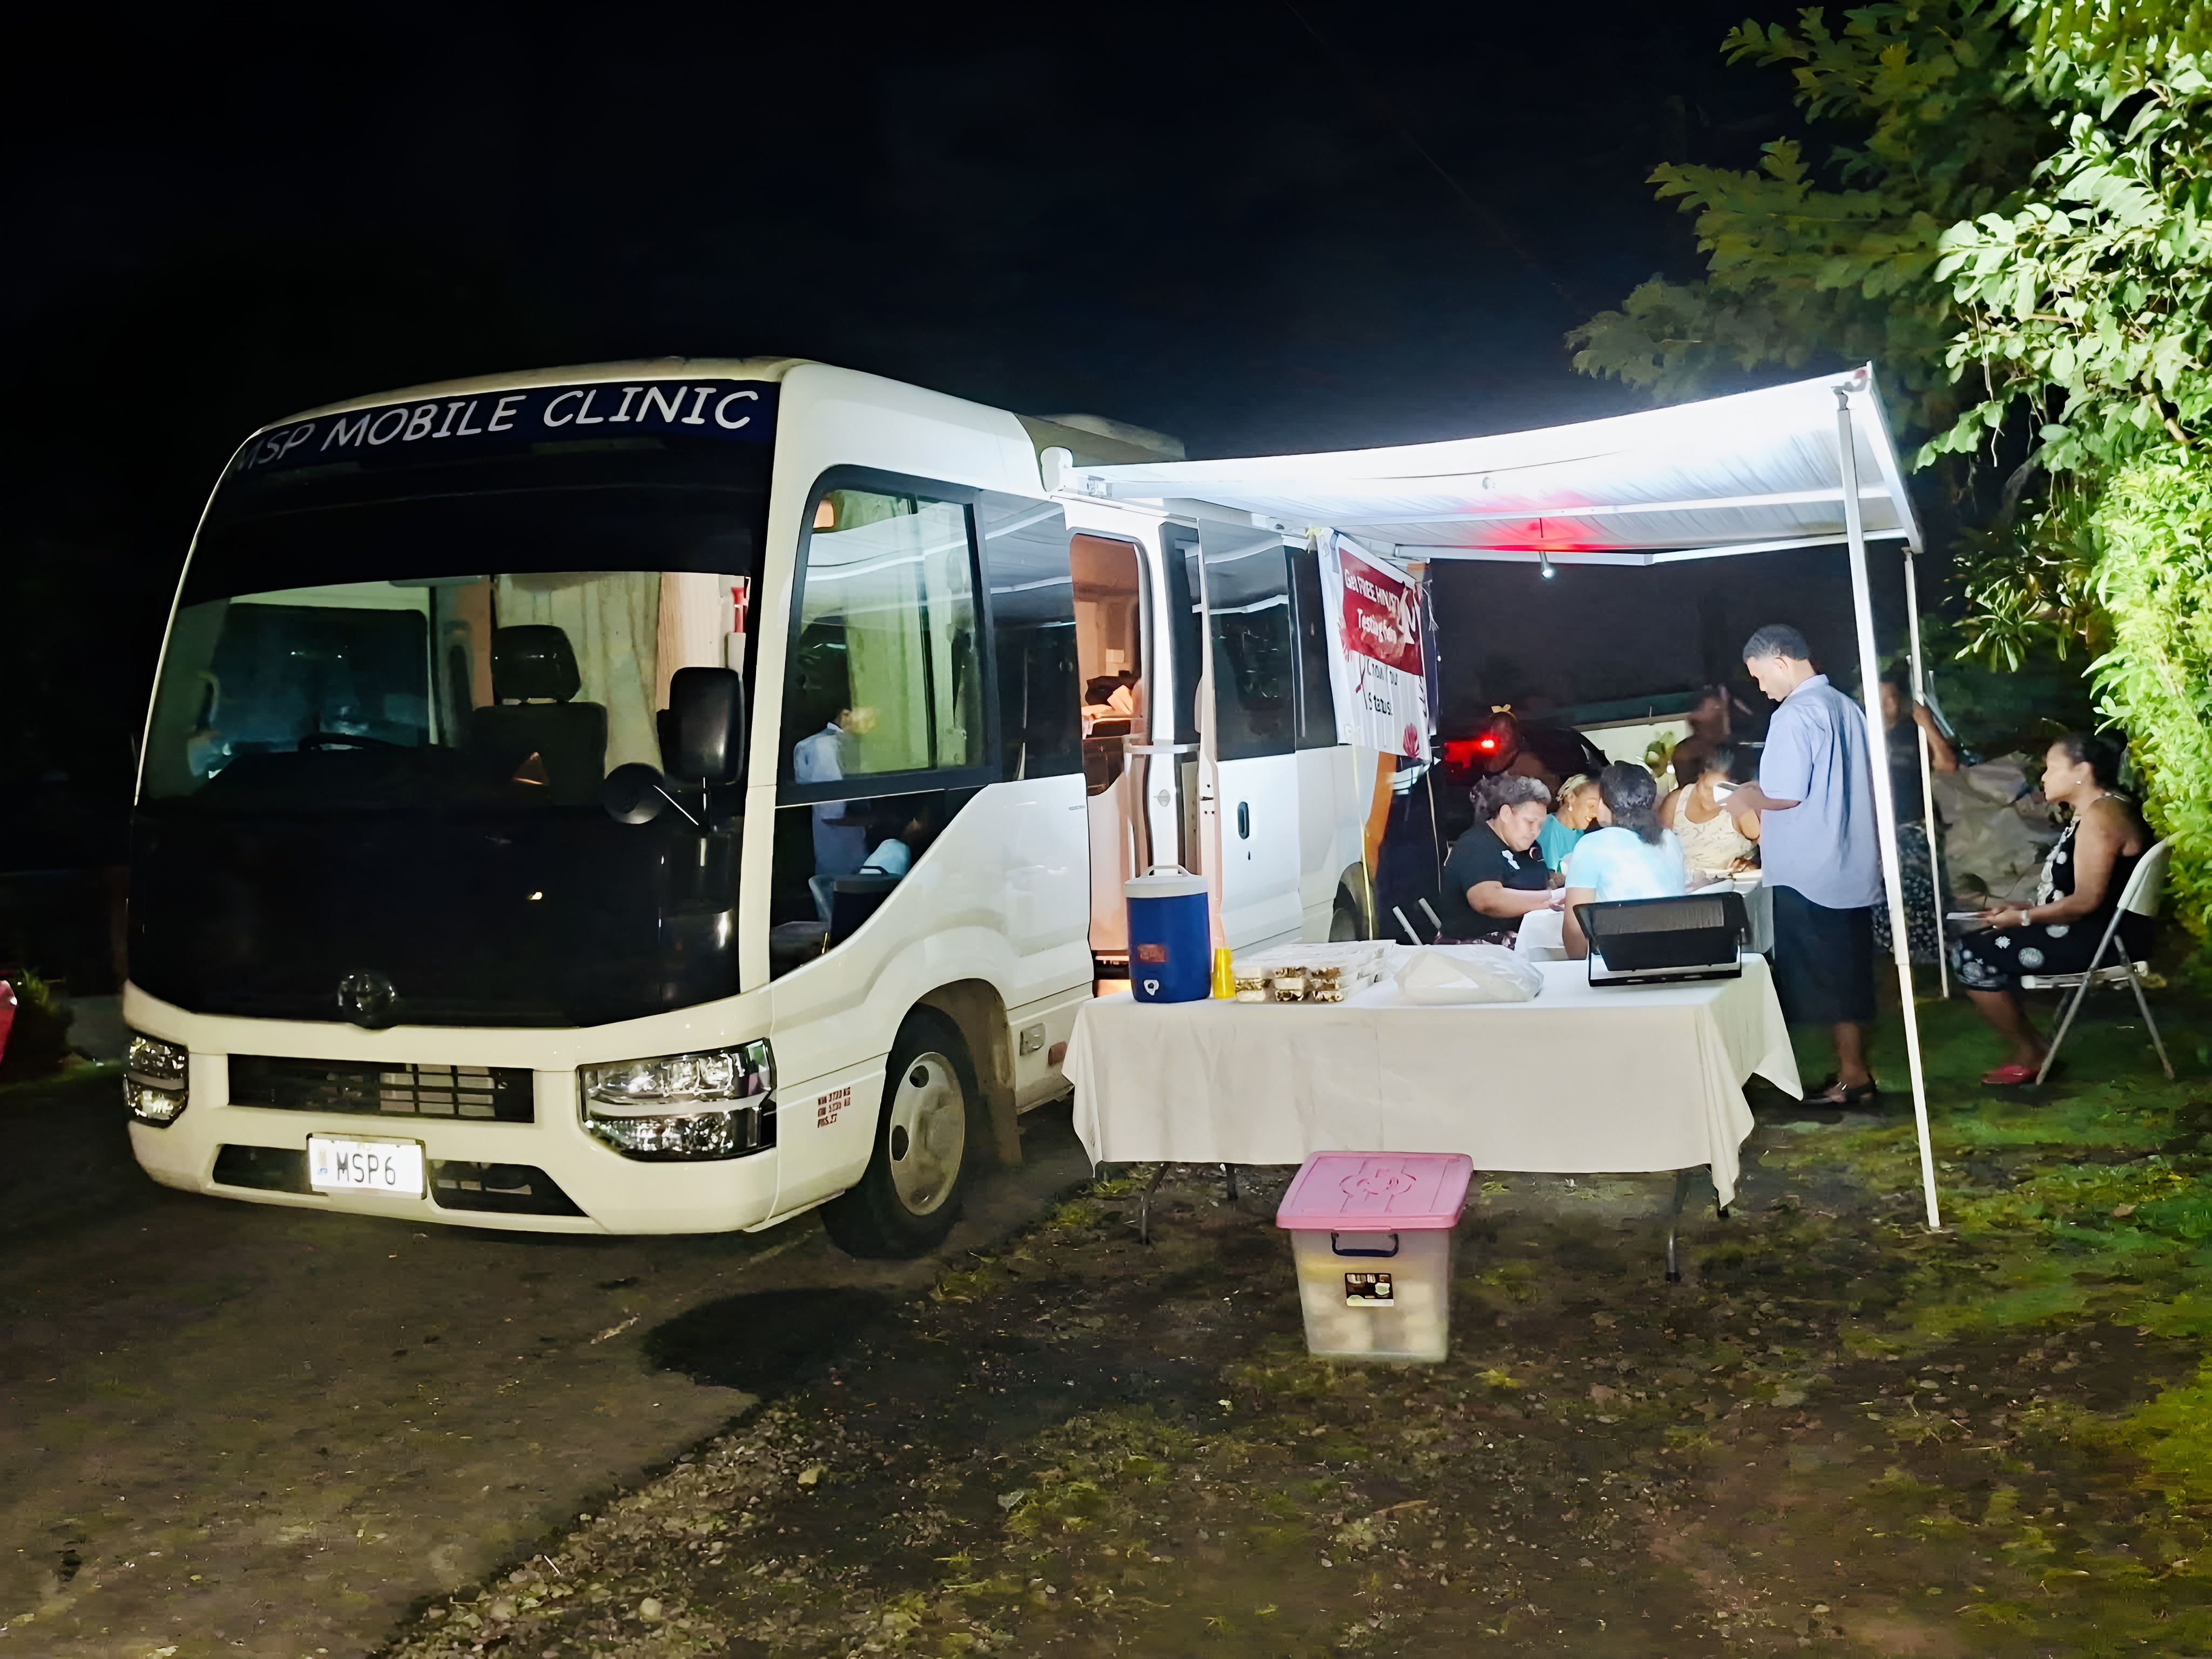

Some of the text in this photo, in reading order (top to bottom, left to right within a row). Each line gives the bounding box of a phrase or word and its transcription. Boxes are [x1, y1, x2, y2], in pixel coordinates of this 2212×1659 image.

[237, 386, 758, 471] MSP MOBILE CLINIC
